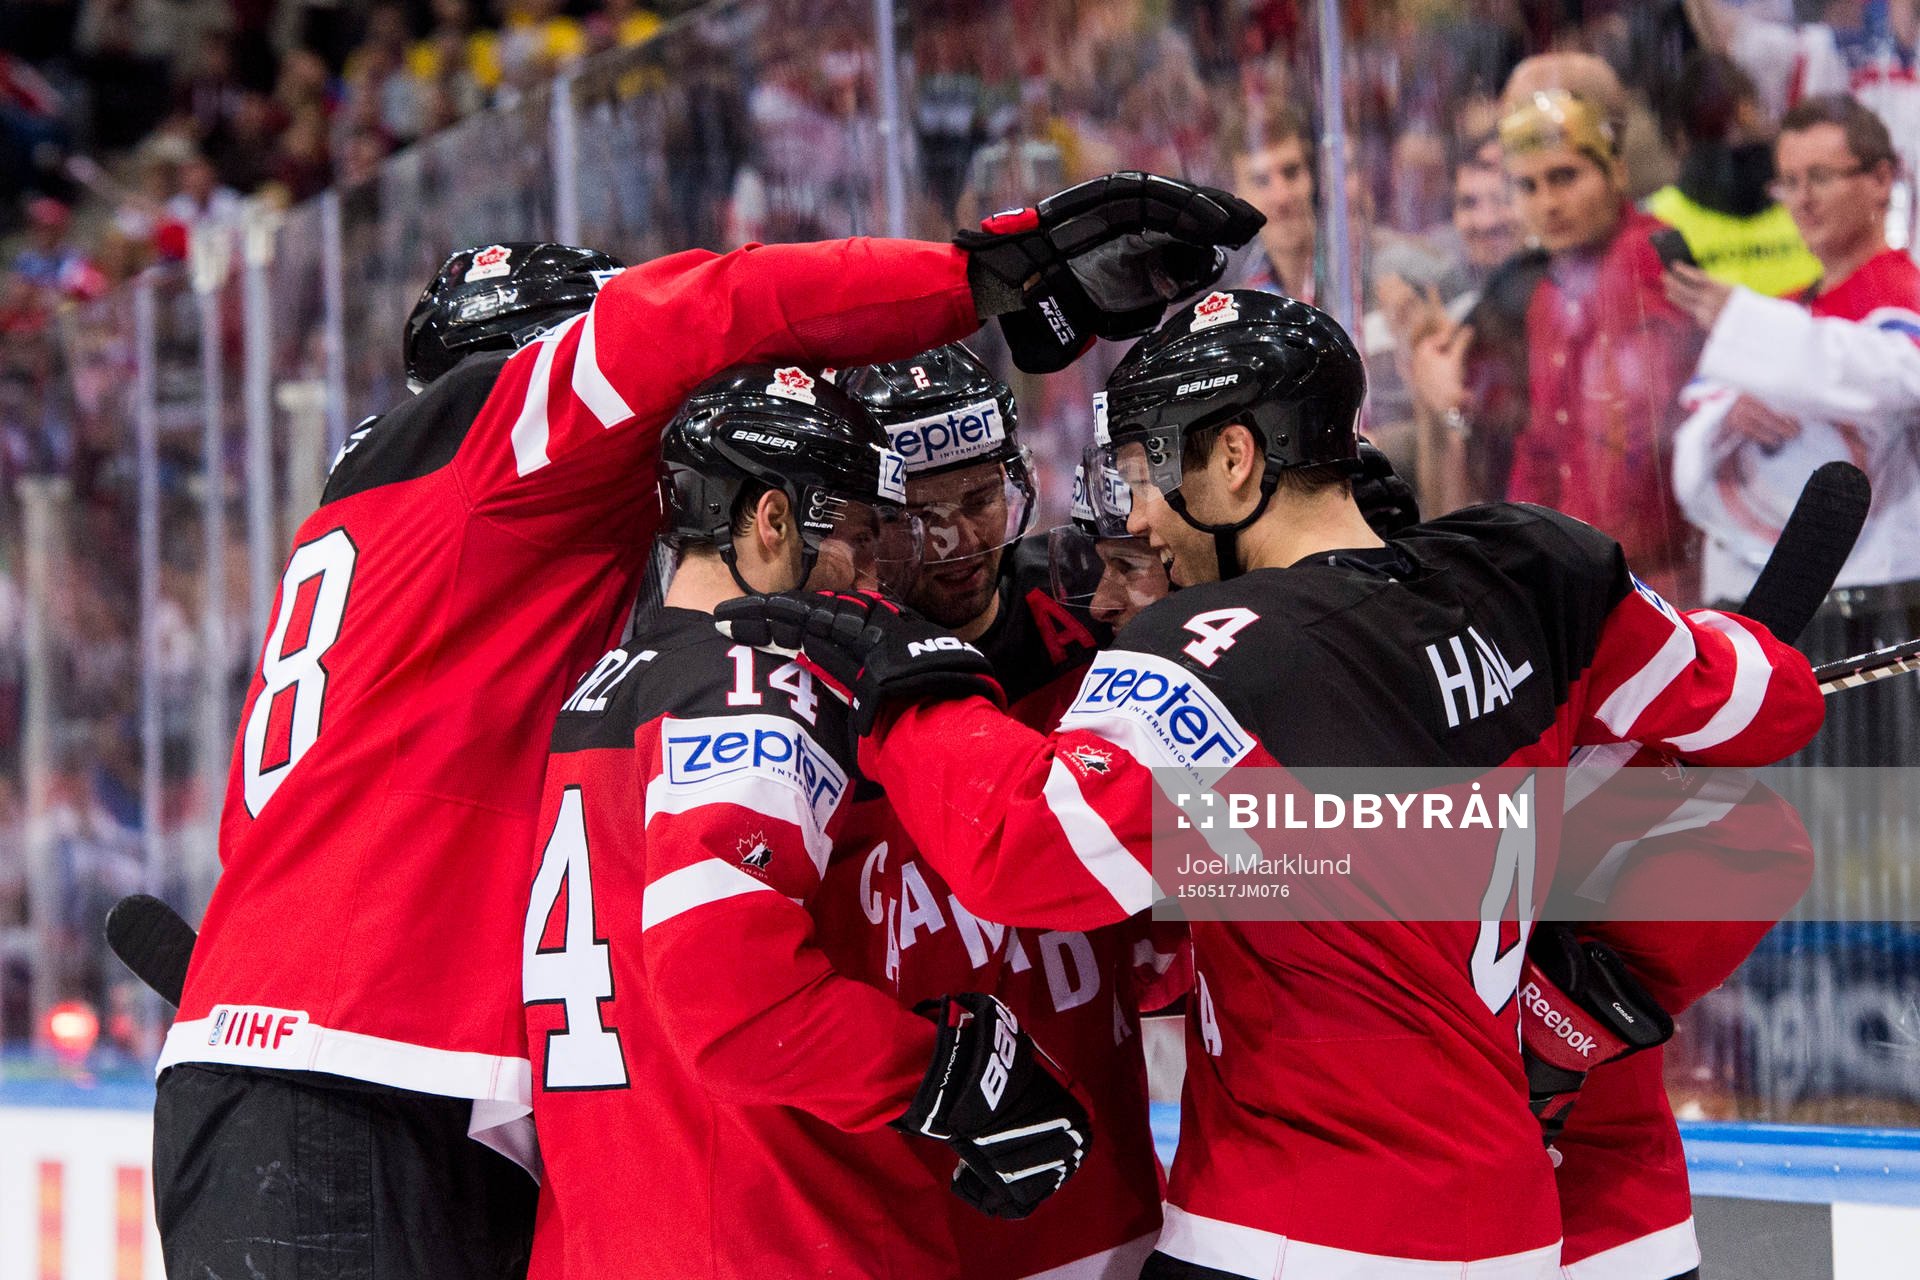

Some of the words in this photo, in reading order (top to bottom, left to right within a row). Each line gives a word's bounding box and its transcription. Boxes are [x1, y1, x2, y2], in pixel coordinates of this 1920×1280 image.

[909, 366, 931, 390] 2
[1025, 587, 1097, 666] A
[1181, 607, 1262, 669] 4
[725, 644, 819, 727] 14
[1086, 667, 1237, 763] zepter
[668, 729, 839, 810] zepter
[1129, 705, 1205, 787] INTERNATIONAL
[523, 785, 630, 1091] 4
[224, 1011, 299, 1050] IIHF
[1519, 981, 1597, 1058] Reebok
[1612, 1002, 1635, 1024] Canada
